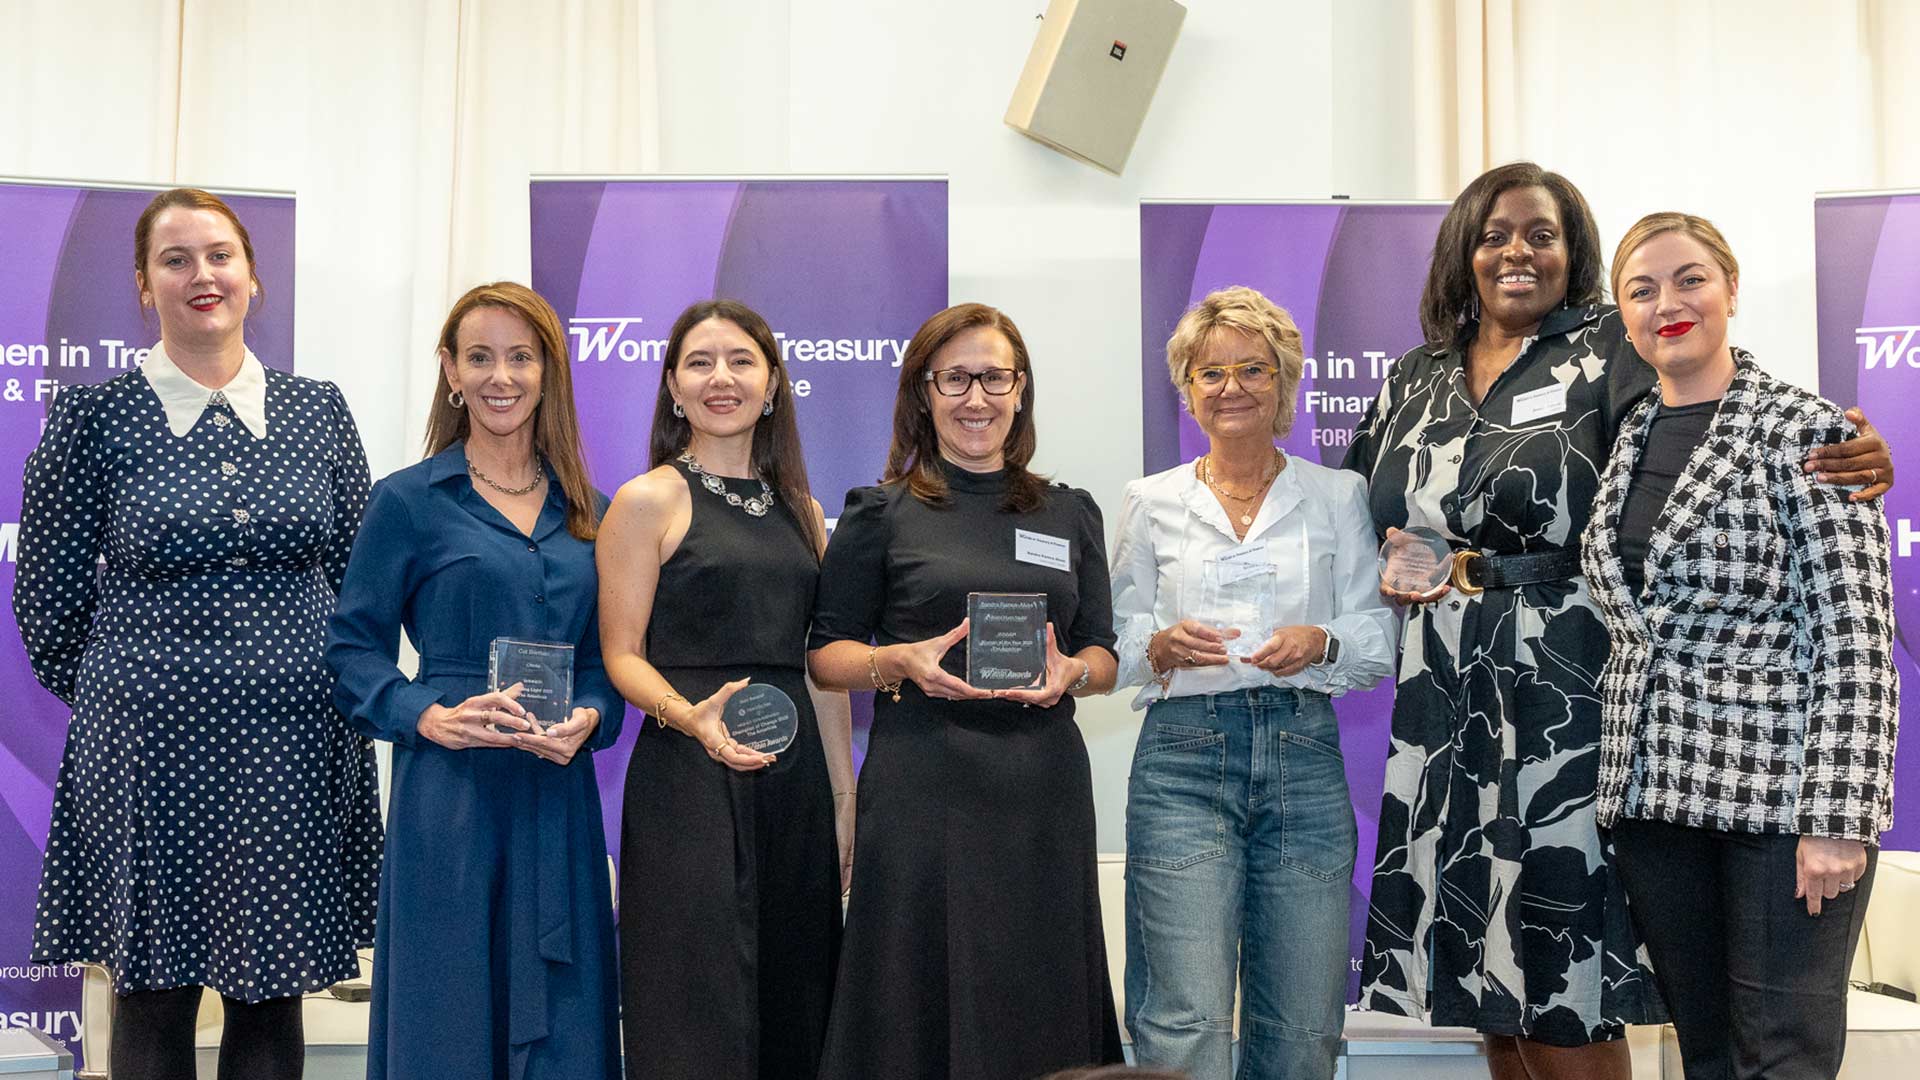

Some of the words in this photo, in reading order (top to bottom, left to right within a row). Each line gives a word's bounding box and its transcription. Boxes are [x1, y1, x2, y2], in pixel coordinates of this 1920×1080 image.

[0, 343, 49, 366] en
[60, 338, 90, 367] in
[1327, 351, 1355, 379] in
[3, 378, 25, 402] &
[63, 963, 80, 978] to
